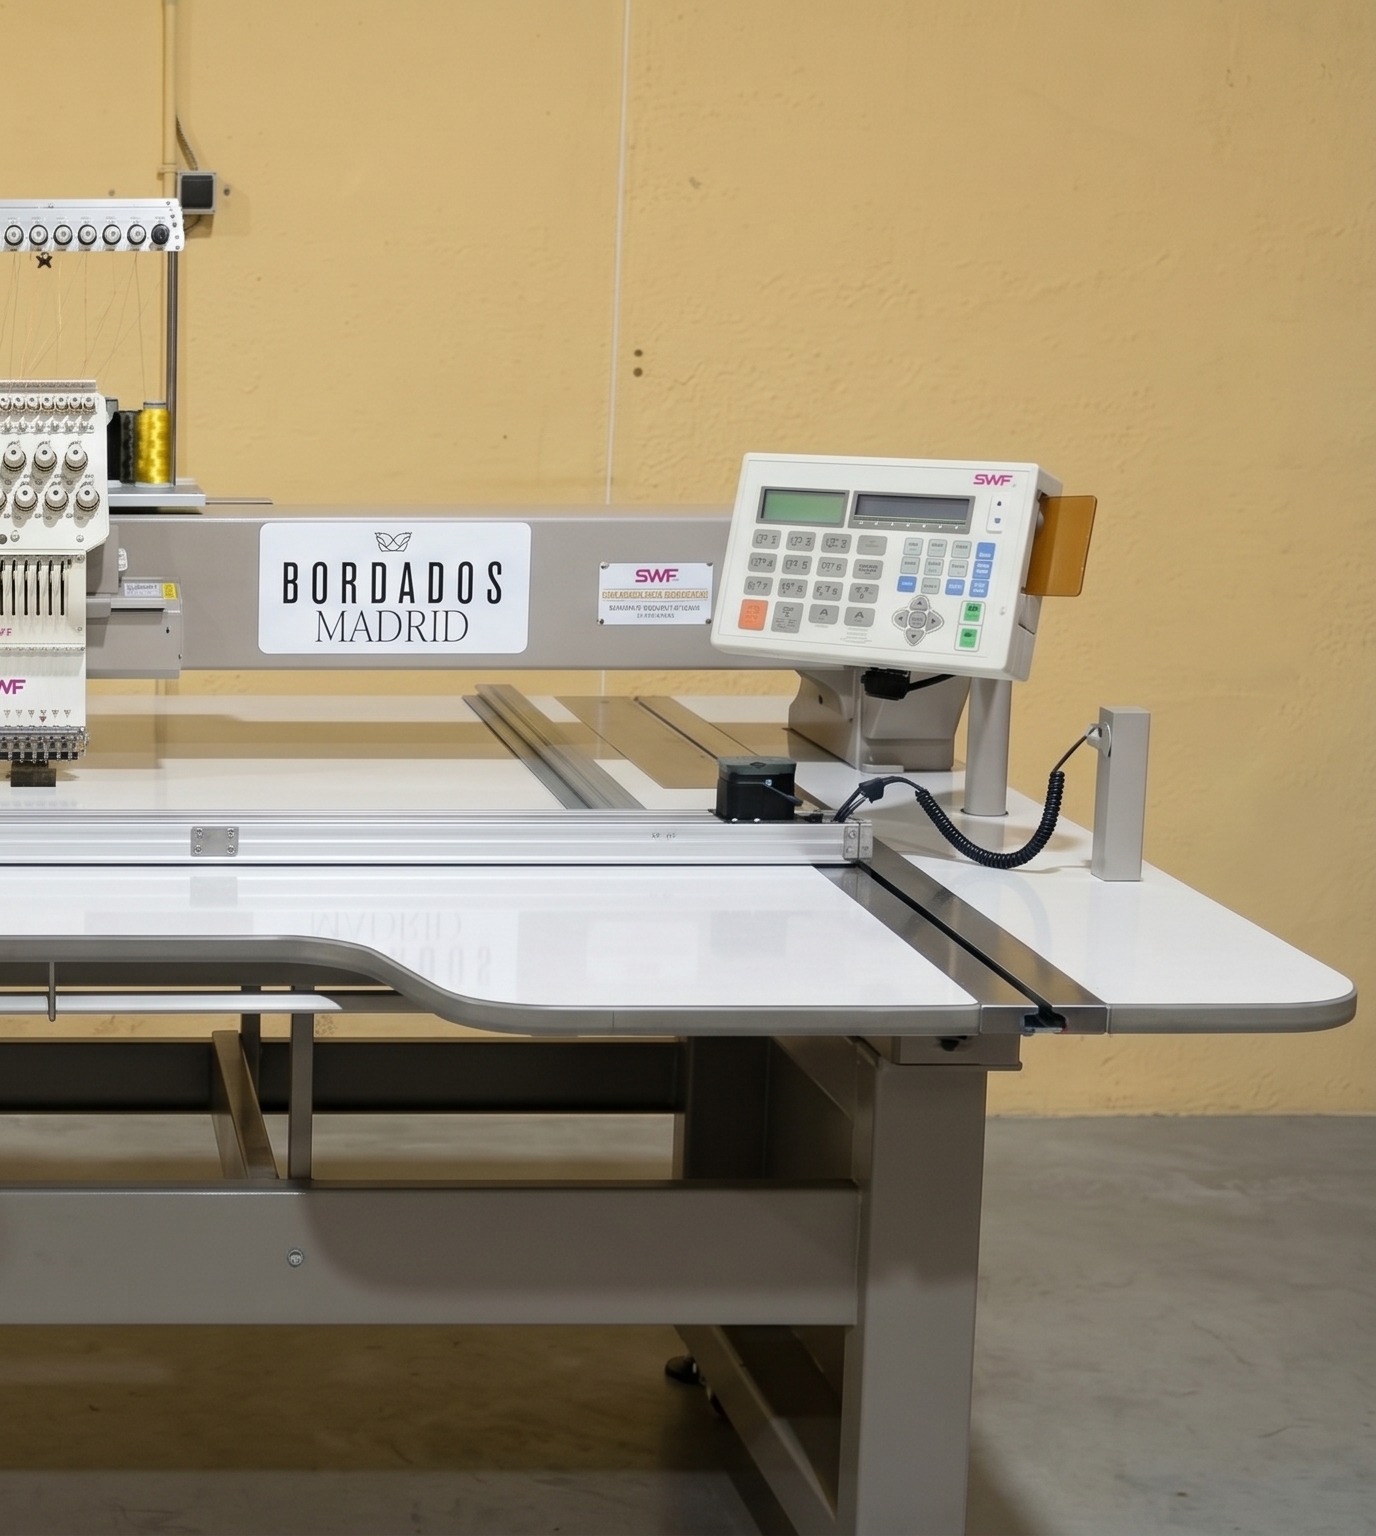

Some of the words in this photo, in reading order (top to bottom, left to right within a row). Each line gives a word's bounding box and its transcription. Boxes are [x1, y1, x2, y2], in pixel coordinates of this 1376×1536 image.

[973, 474, 1013, 486] SWF
[283, 561, 502, 605] BORDADOS
[635, 568, 679, 583] SWF
[315, 610, 469, 643] MADRID
